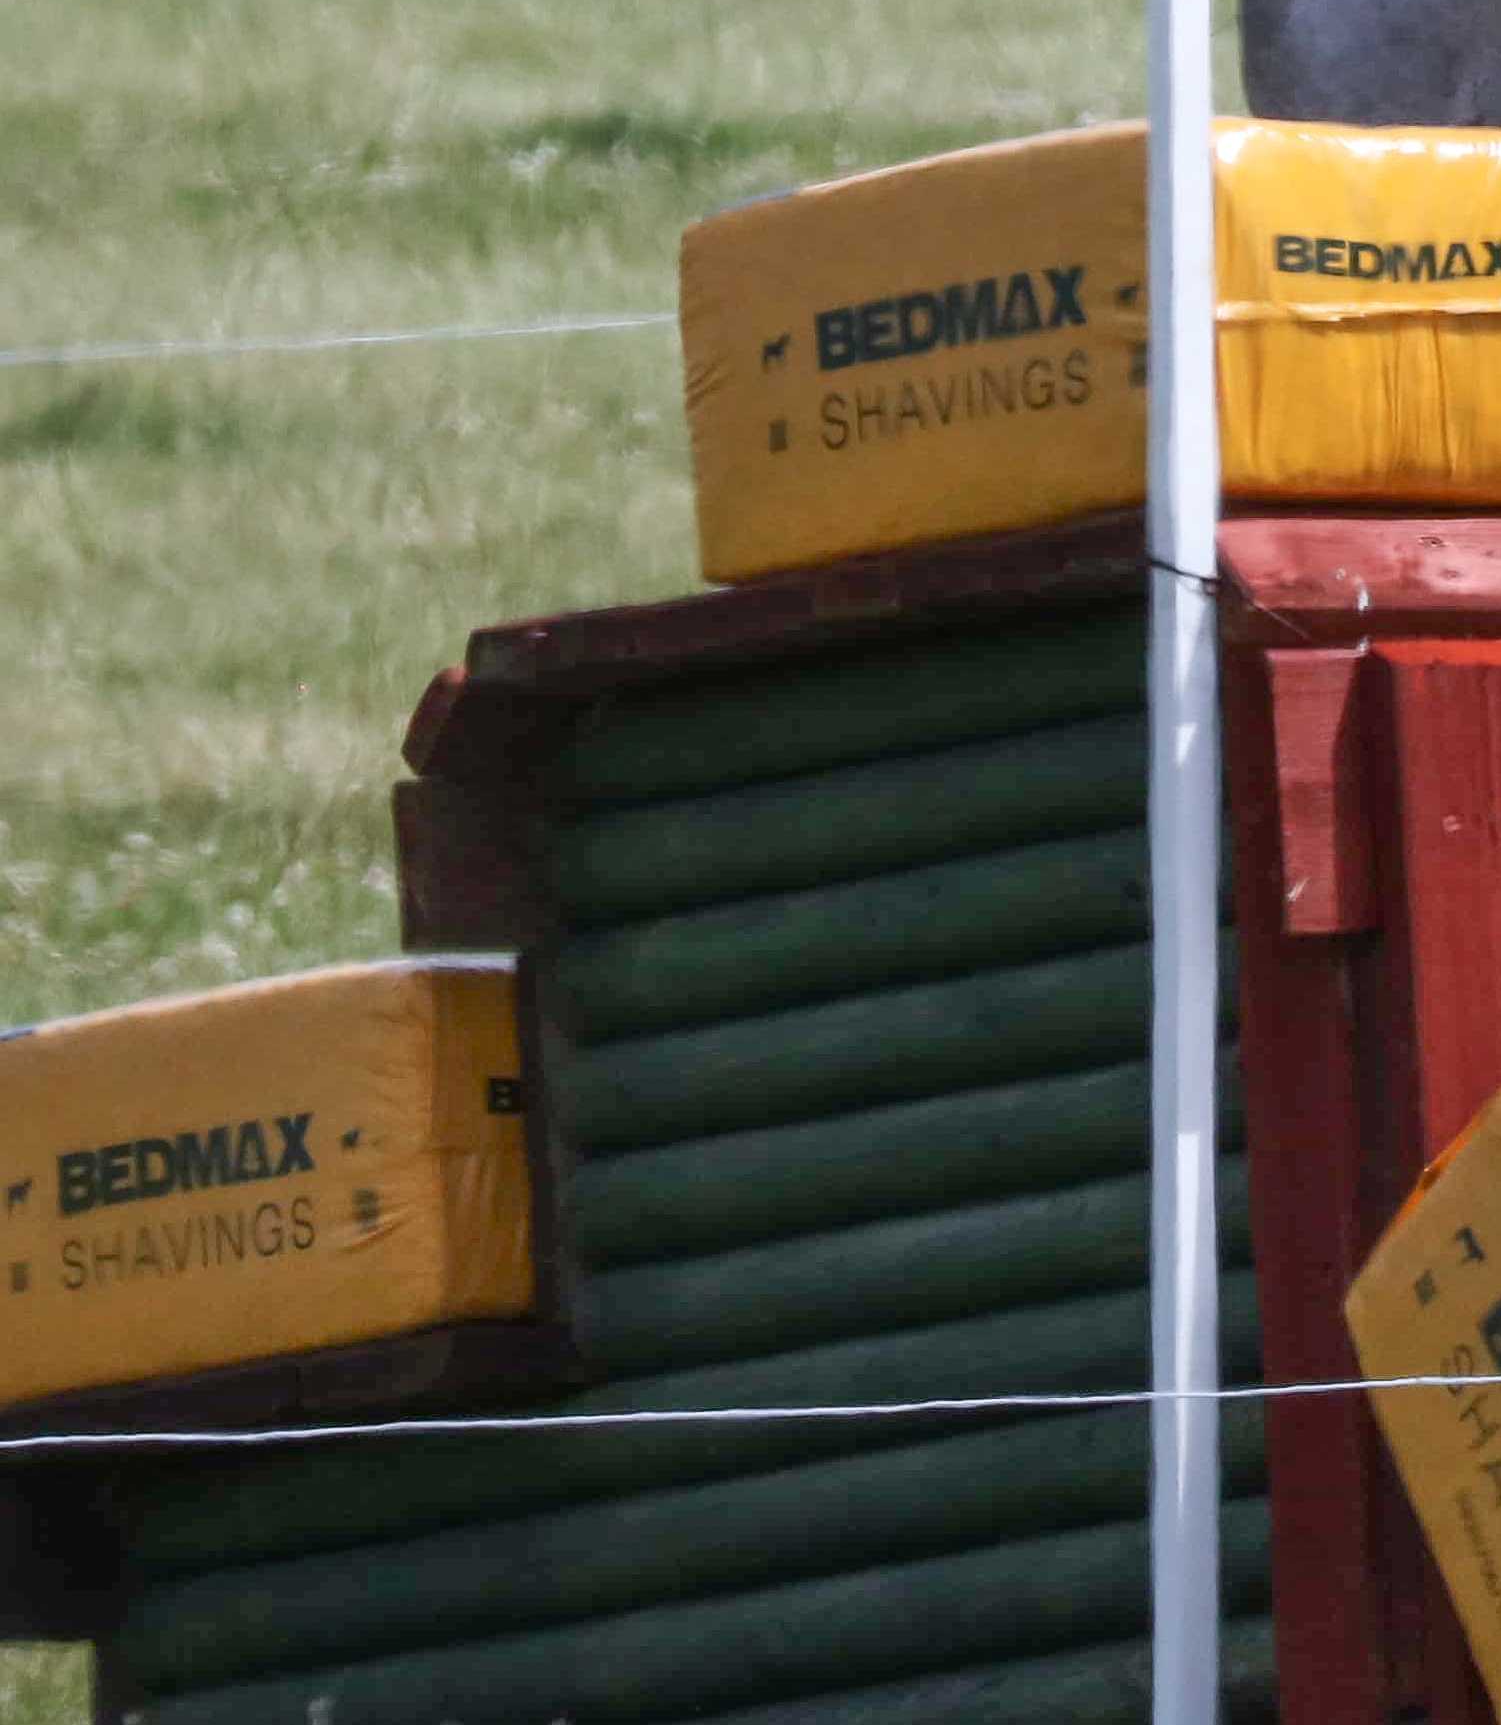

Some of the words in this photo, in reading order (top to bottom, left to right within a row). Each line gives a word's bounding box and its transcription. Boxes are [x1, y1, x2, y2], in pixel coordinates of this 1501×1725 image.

[814, 266, 1089, 370] BEDMAX
[820, 348, 1092, 451] SHAVINGS
[57, 1113, 314, 1215] BEDMAX
[62, 1196, 317, 1291] SHAVINGS
